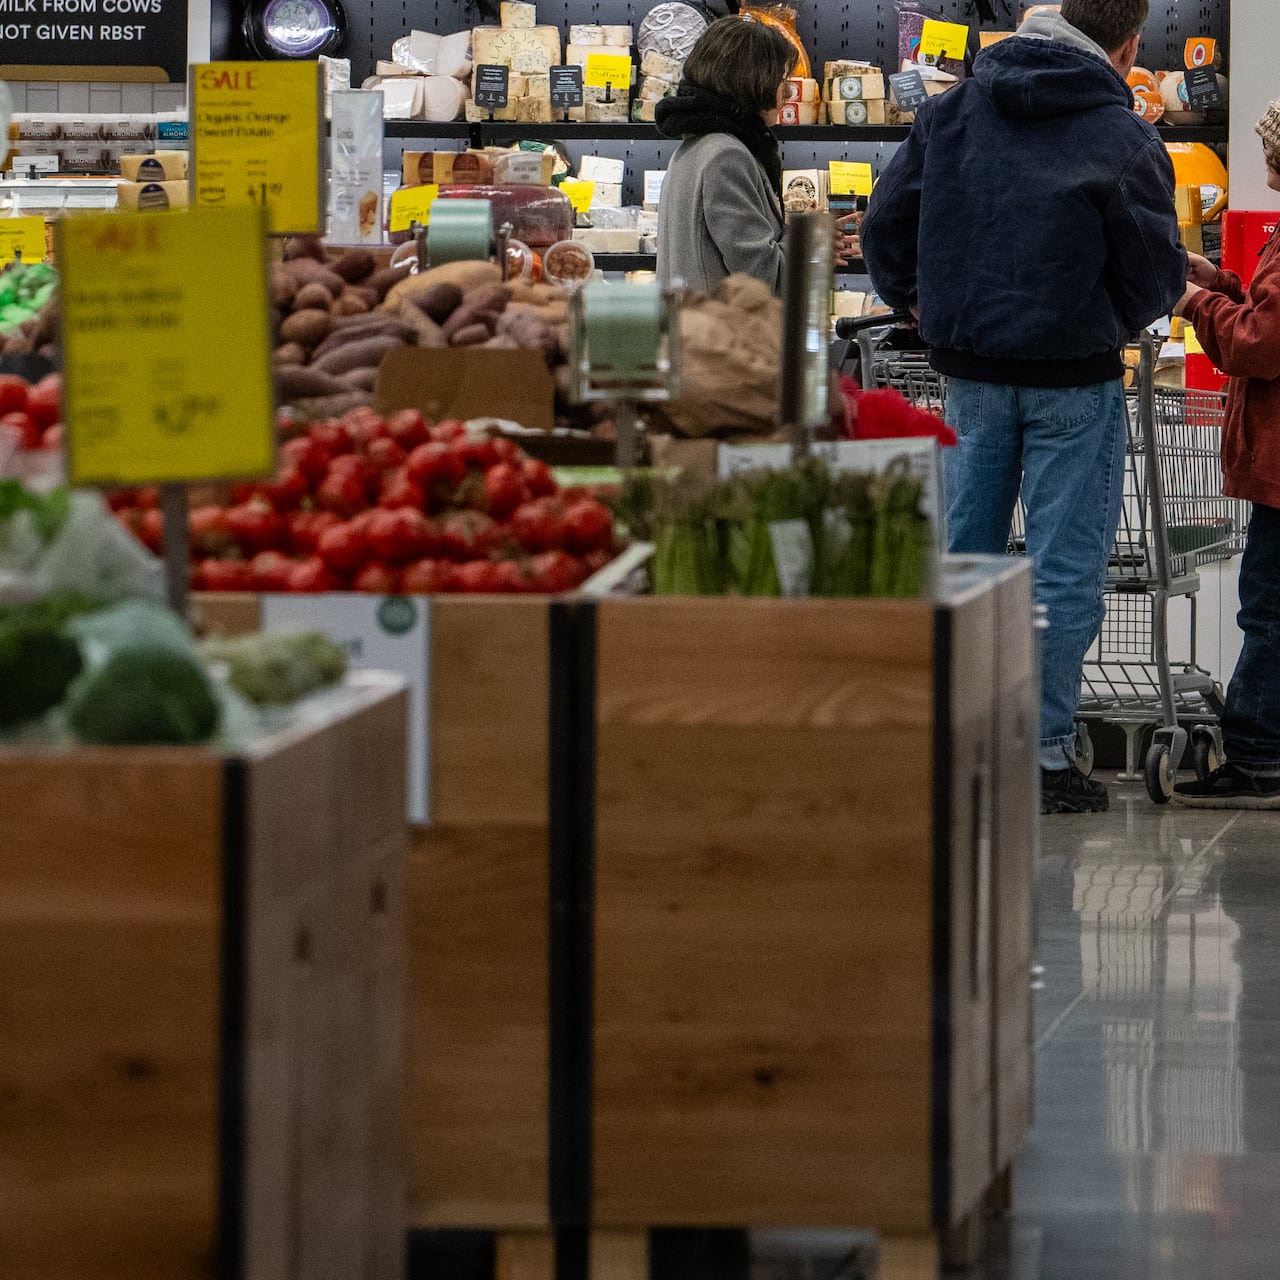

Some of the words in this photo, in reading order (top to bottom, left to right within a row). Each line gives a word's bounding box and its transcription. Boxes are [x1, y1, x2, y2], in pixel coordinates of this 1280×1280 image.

[36, 24, 93, 40] GIVEN
[100, 25, 146, 41] RBST
[200, 68, 258, 91] SALE
